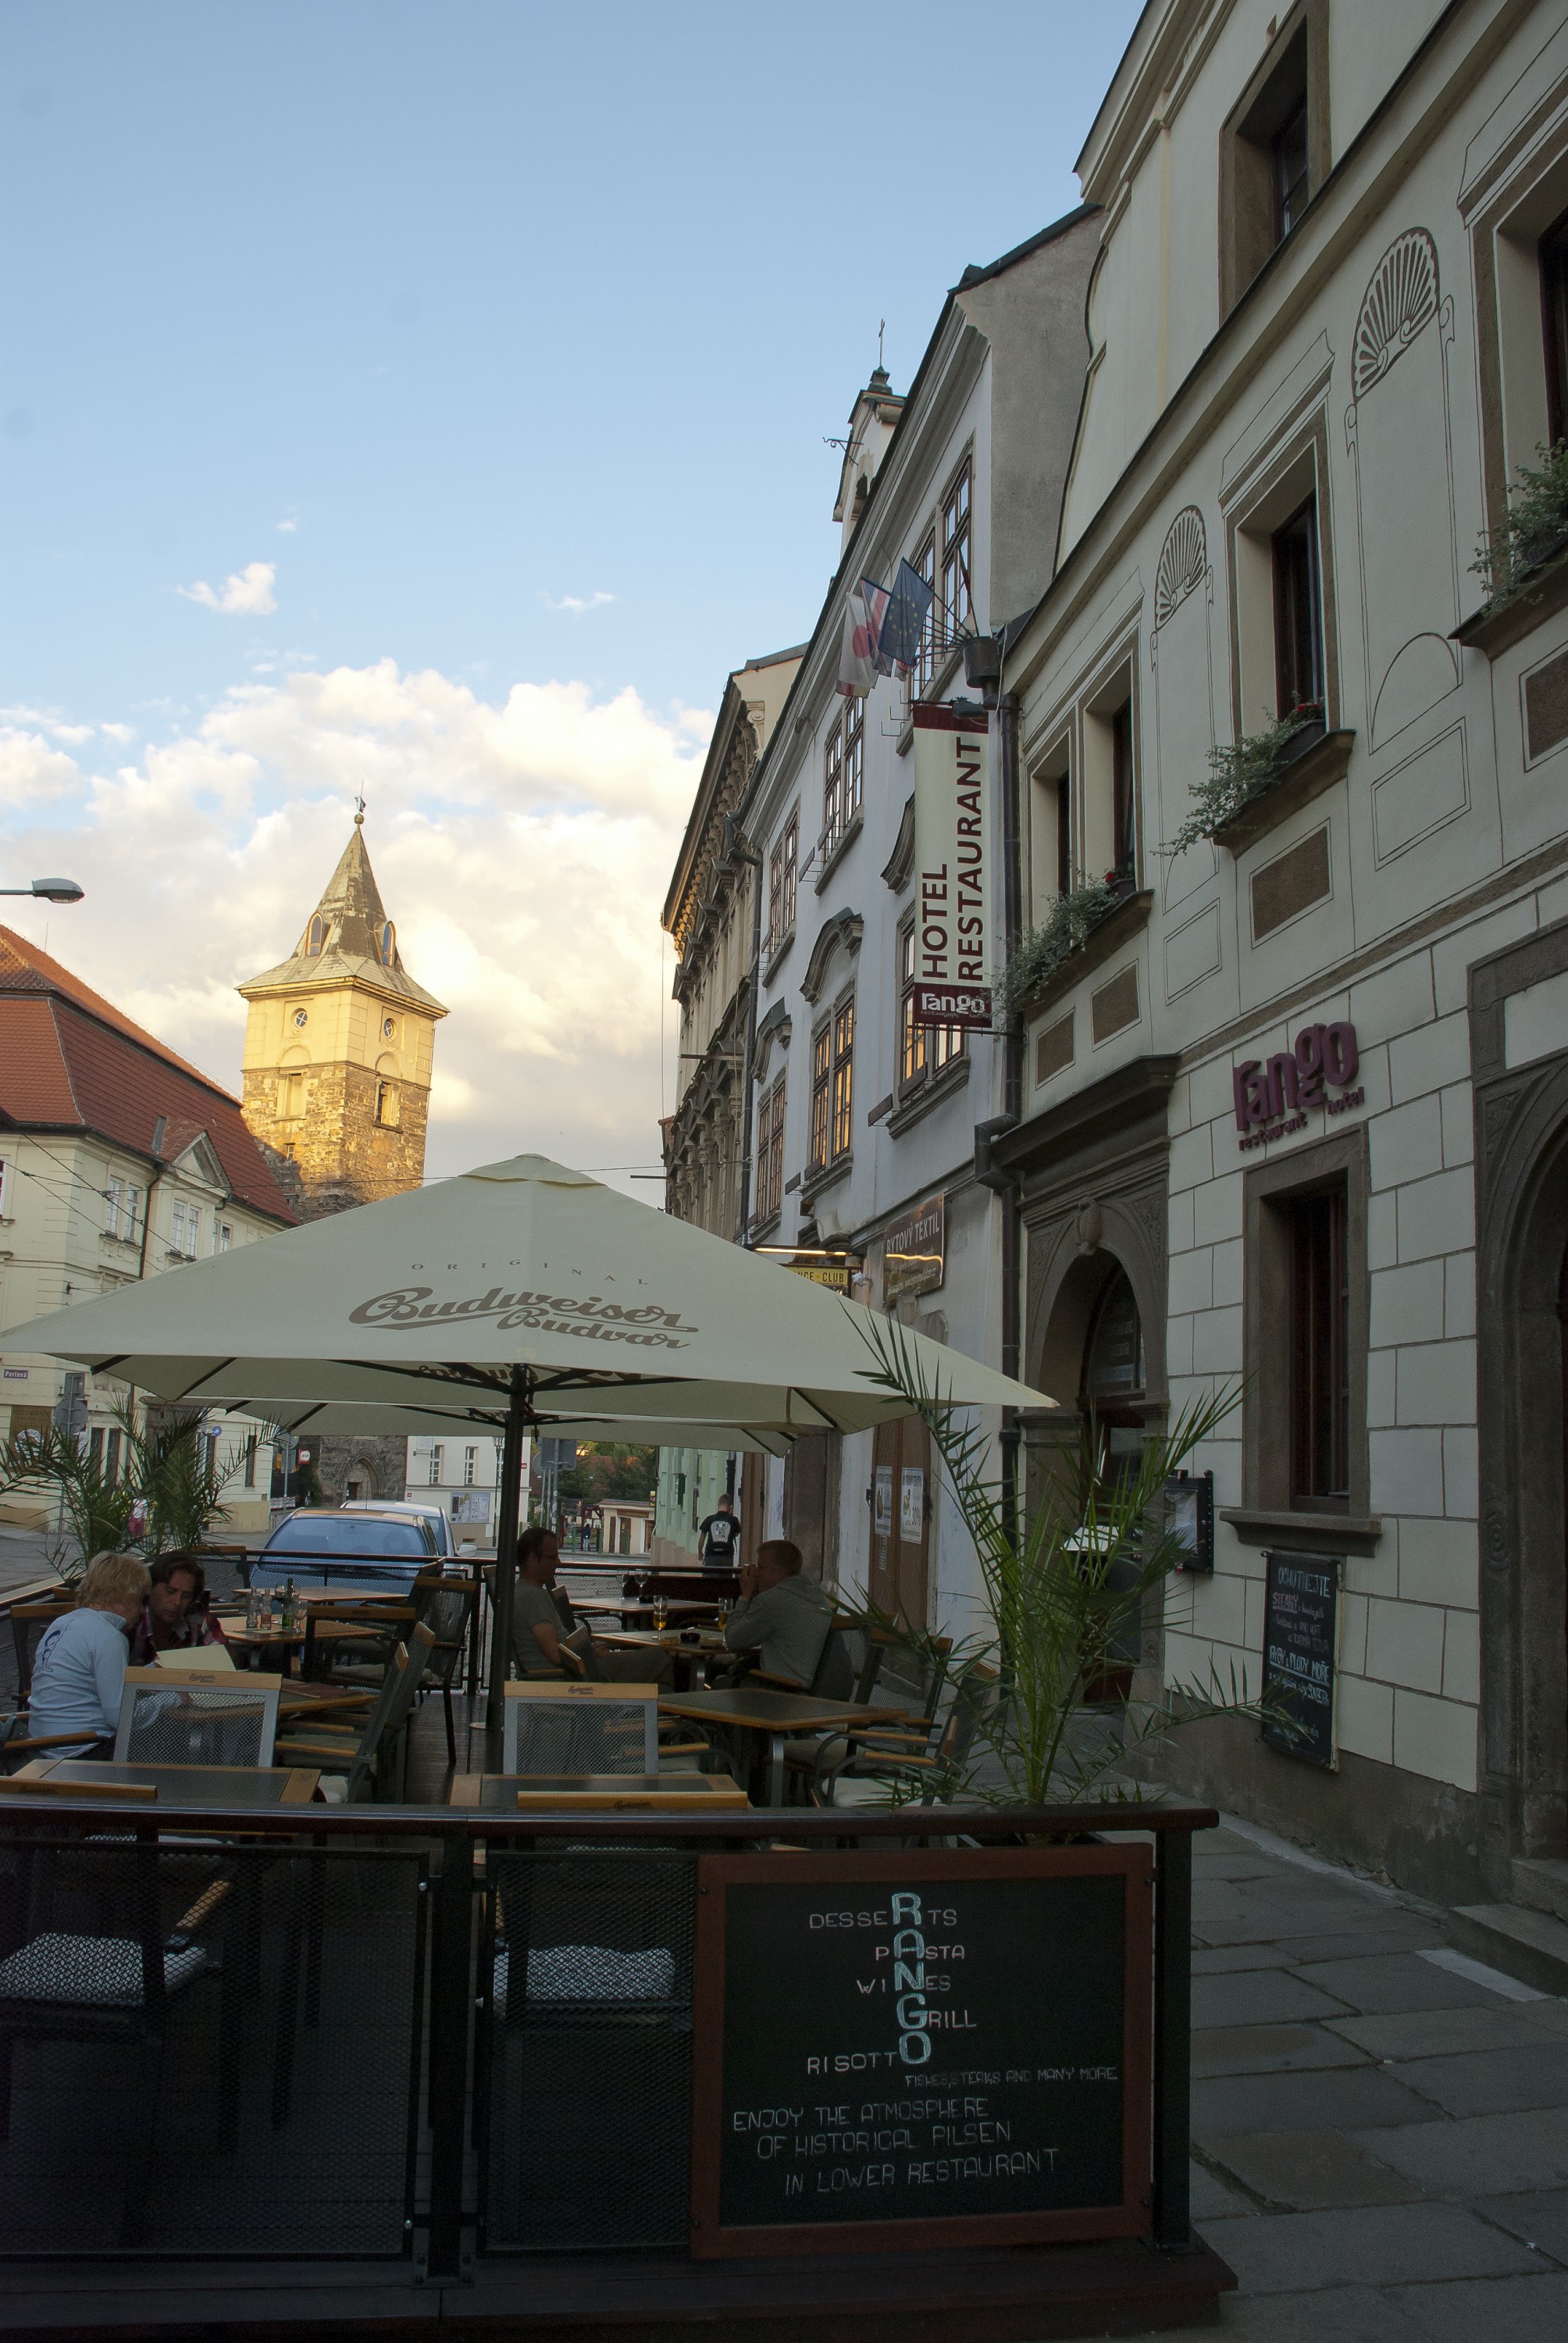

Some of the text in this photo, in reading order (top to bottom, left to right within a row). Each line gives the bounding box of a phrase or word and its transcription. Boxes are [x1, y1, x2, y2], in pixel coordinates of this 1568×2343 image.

[956, 736, 984, 982] RESTAURANT
[921, 863, 948, 979] HOTEL
[921, 993, 985, 1015] rango
[1232, 1021, 1360, 1132] rango
[1238, 1111, 1308, 1151] restaurant
[886, 1212, 940, 1254] BYTOVÝ TEXTIL
[411, 1259, 648, 1286] ORIGINAL
[822, 1271, 845, 1283] CLUB
[348, 1286, 700, 1332] Budweiser
[496, 1307, 691, 1349] Budvar
[809, 1892, 958, 1929] DESSERTS
[875, 1928, 966, 1961] PASTA
[856, 1960, 951, 1994] WINES
[896, 1992, 978, 2031] GRILL
[807, 2031, 932, 2075] RISOTTO
[1006, 2070, 1032, 2083] AND
[1037, 2067, 1075, 2081] MANY
[1079, 2067, 1118, 2082] MORE
[732, 2097, 989, 2131] ENJOY THE ATMOSPHERE
[757, 2120, 1011, 2159] OF HISTORICAL PILSEN
[785, 2148, 1060, 2196] IN LOWER RESTAURANT
